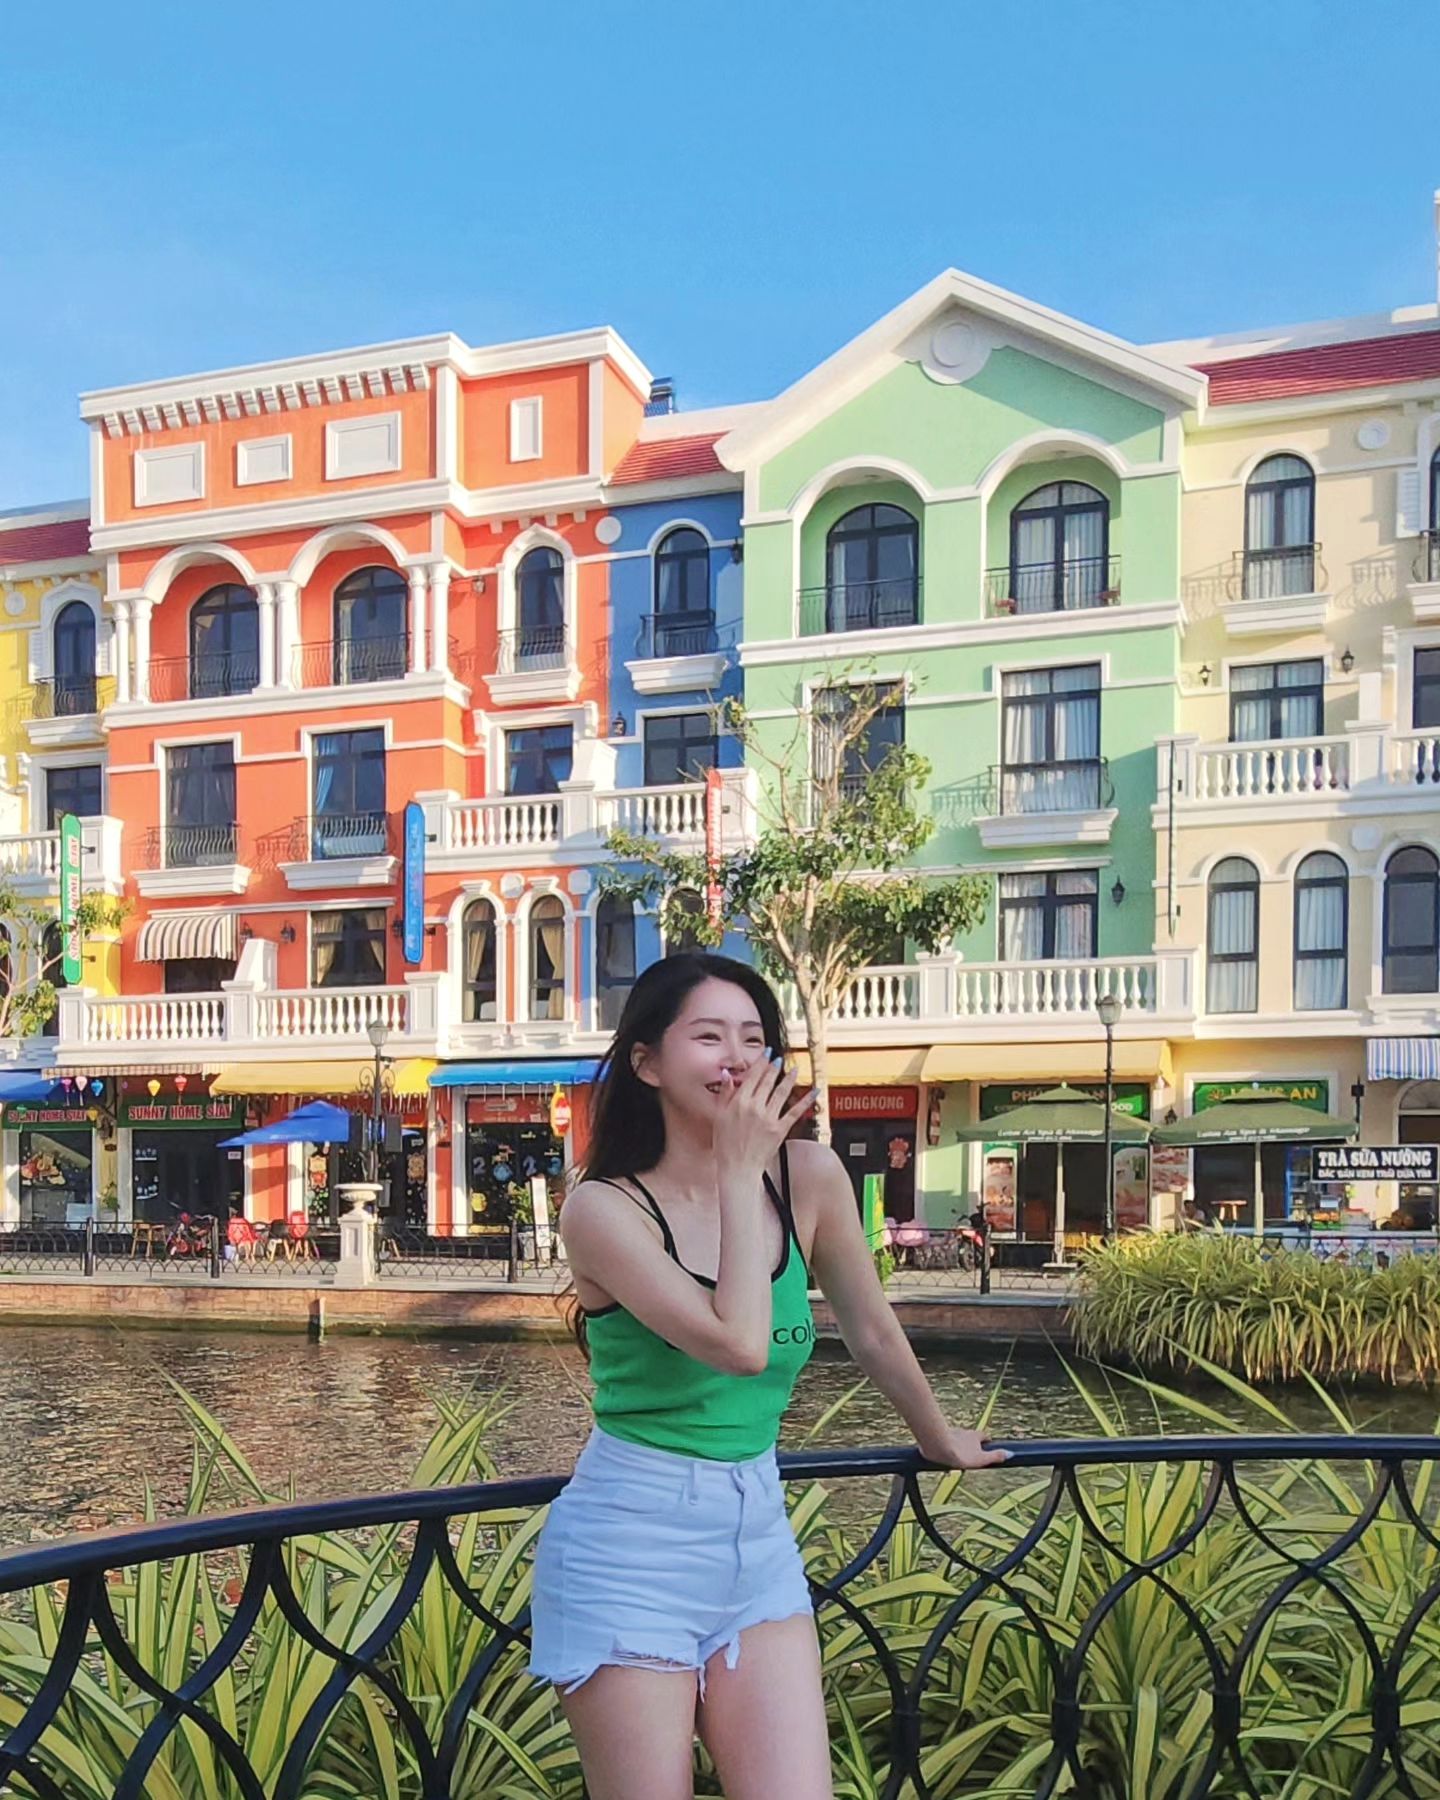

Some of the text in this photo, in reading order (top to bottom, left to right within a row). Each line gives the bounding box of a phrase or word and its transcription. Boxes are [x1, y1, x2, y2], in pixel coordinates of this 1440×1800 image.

[1290, 1087, 1317, 1100] AN
[835, 1096, 904, 1110] HONGKONG
[128, 1106, 166, 1119] SUNNY
[170, 1105, 202, 1119] HOME
[772, 1317, 816, 1345] col
